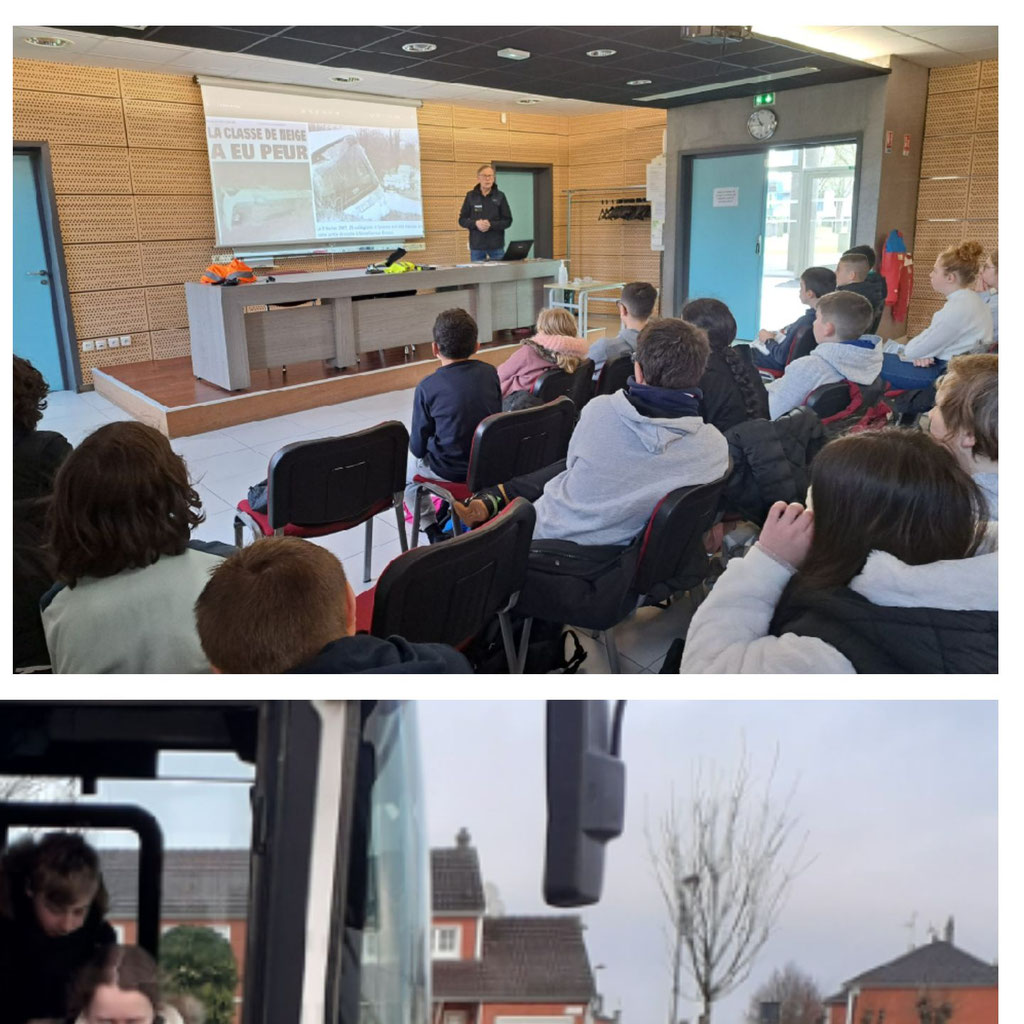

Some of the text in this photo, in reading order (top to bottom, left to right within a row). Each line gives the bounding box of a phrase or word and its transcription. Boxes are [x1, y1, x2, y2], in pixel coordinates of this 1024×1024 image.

[208, 127, 306, 142] LA CLASSE DE NEIGE
[211, 143, 309, 160] A EU PEUR
